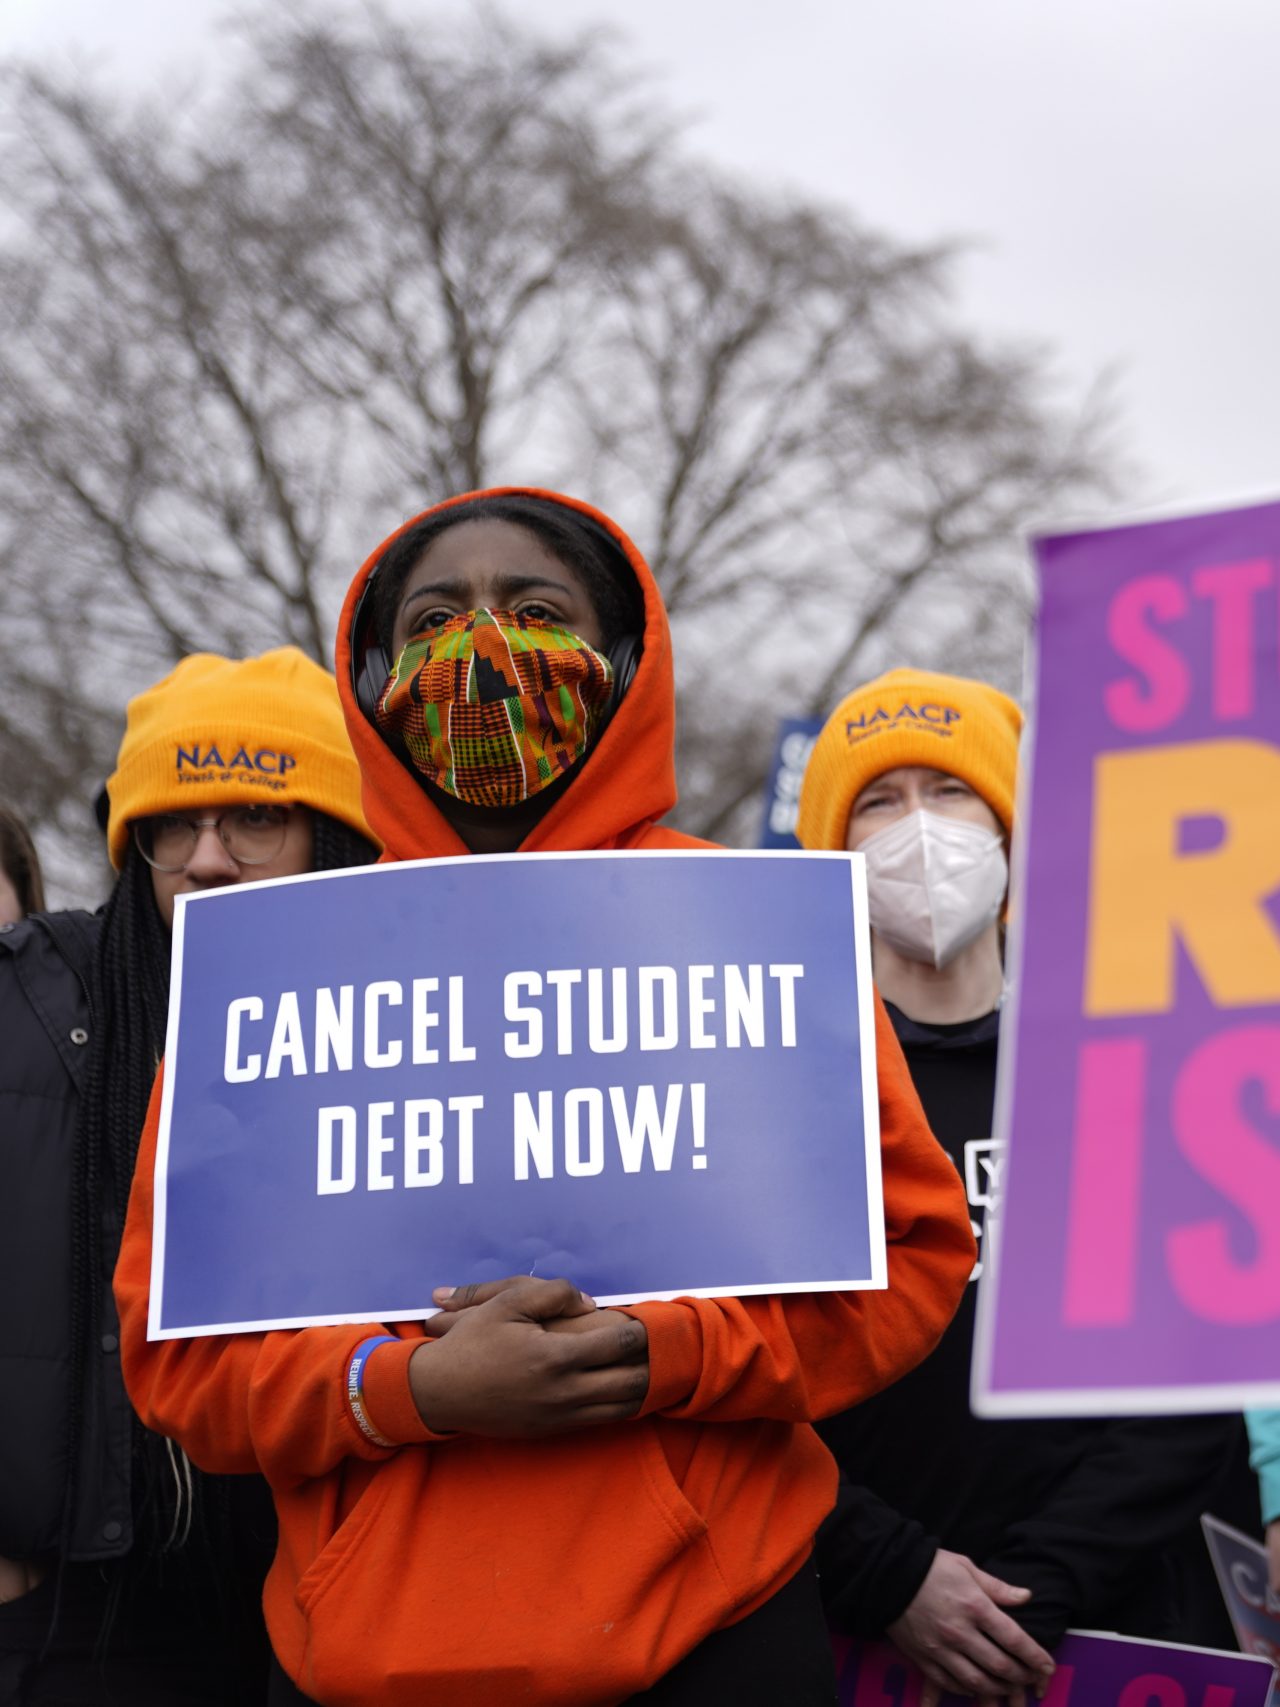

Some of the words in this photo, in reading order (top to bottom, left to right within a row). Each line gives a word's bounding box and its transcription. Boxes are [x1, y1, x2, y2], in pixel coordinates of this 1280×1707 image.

[846, 703, 960, 738] NAACP
[176, 744, 296, 775] NAACP
[238, 772, 287, 791] College
[223, 975, 477, 1083] CANCEL
[503, 964, 804, 1059] STUDENT
[317, 1095, 484, 1196] DEBT
[513, 1082, 707, 1181] NOW!
